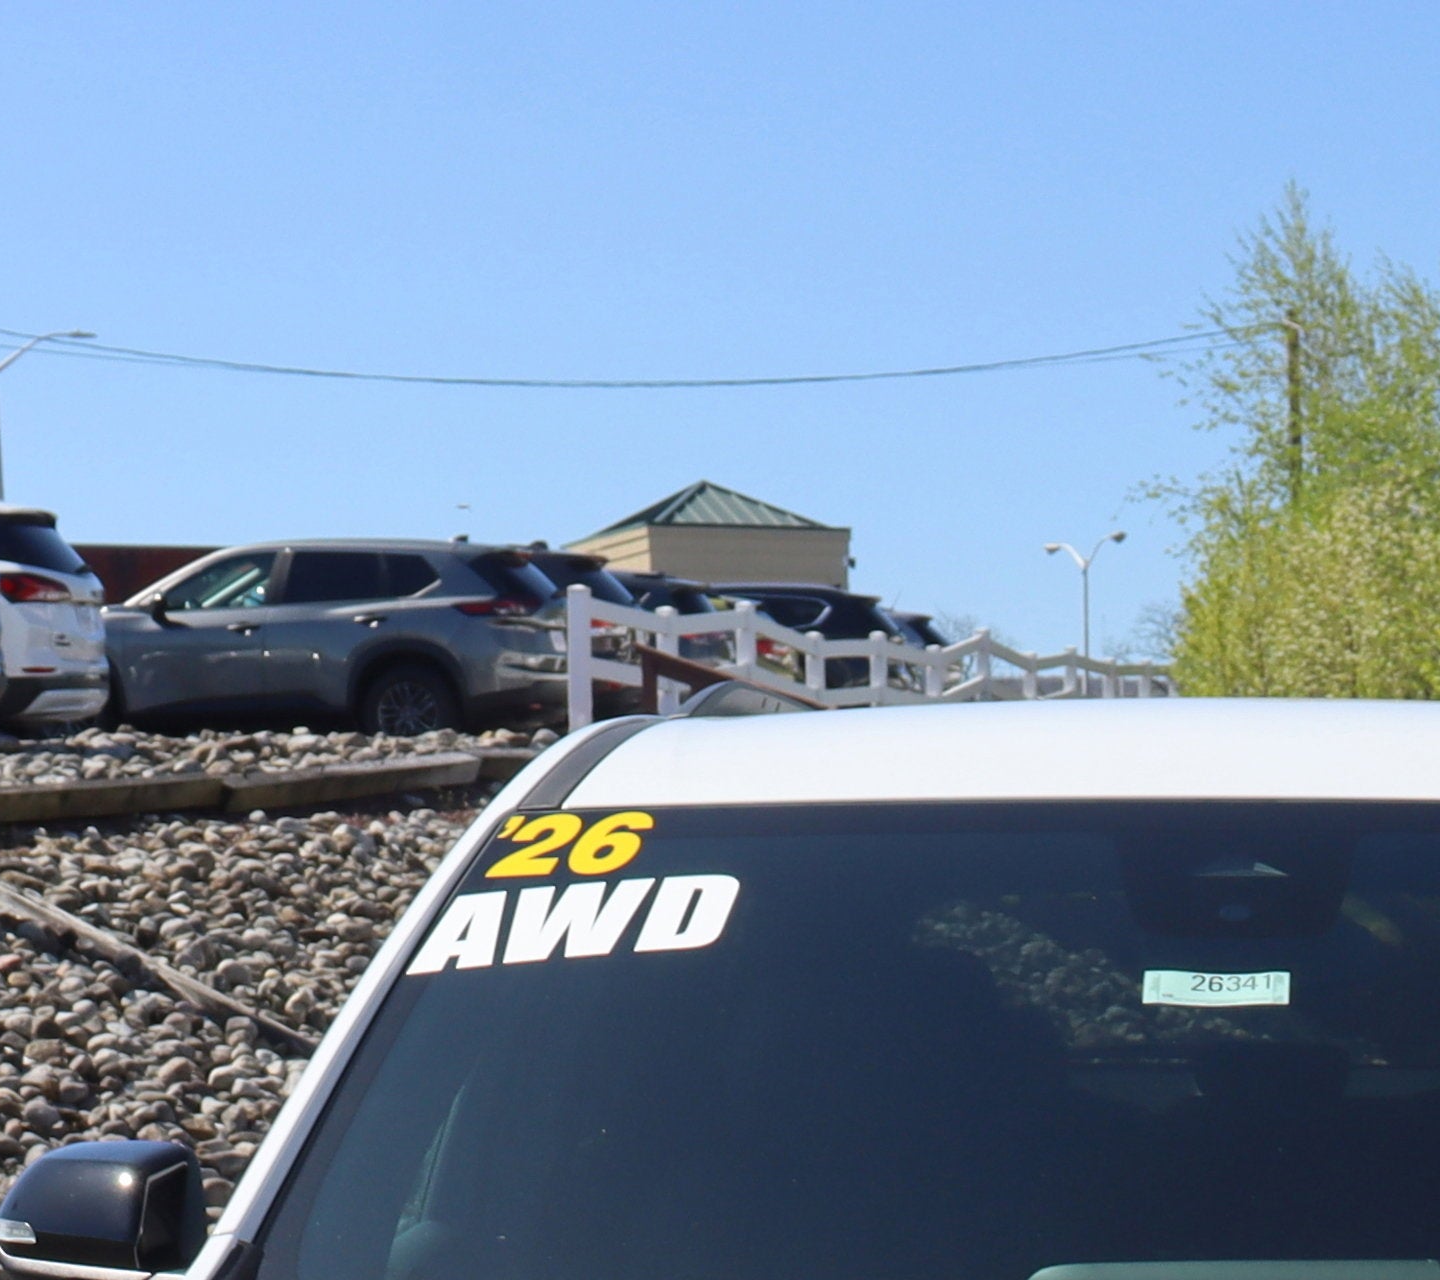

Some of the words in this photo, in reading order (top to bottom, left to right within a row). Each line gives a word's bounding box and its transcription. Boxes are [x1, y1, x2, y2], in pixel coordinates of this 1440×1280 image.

[485, 811, 655, 878] '26
[405, 874, 740, 976] AWD
[1190, 974, 1272, 993] 26341
